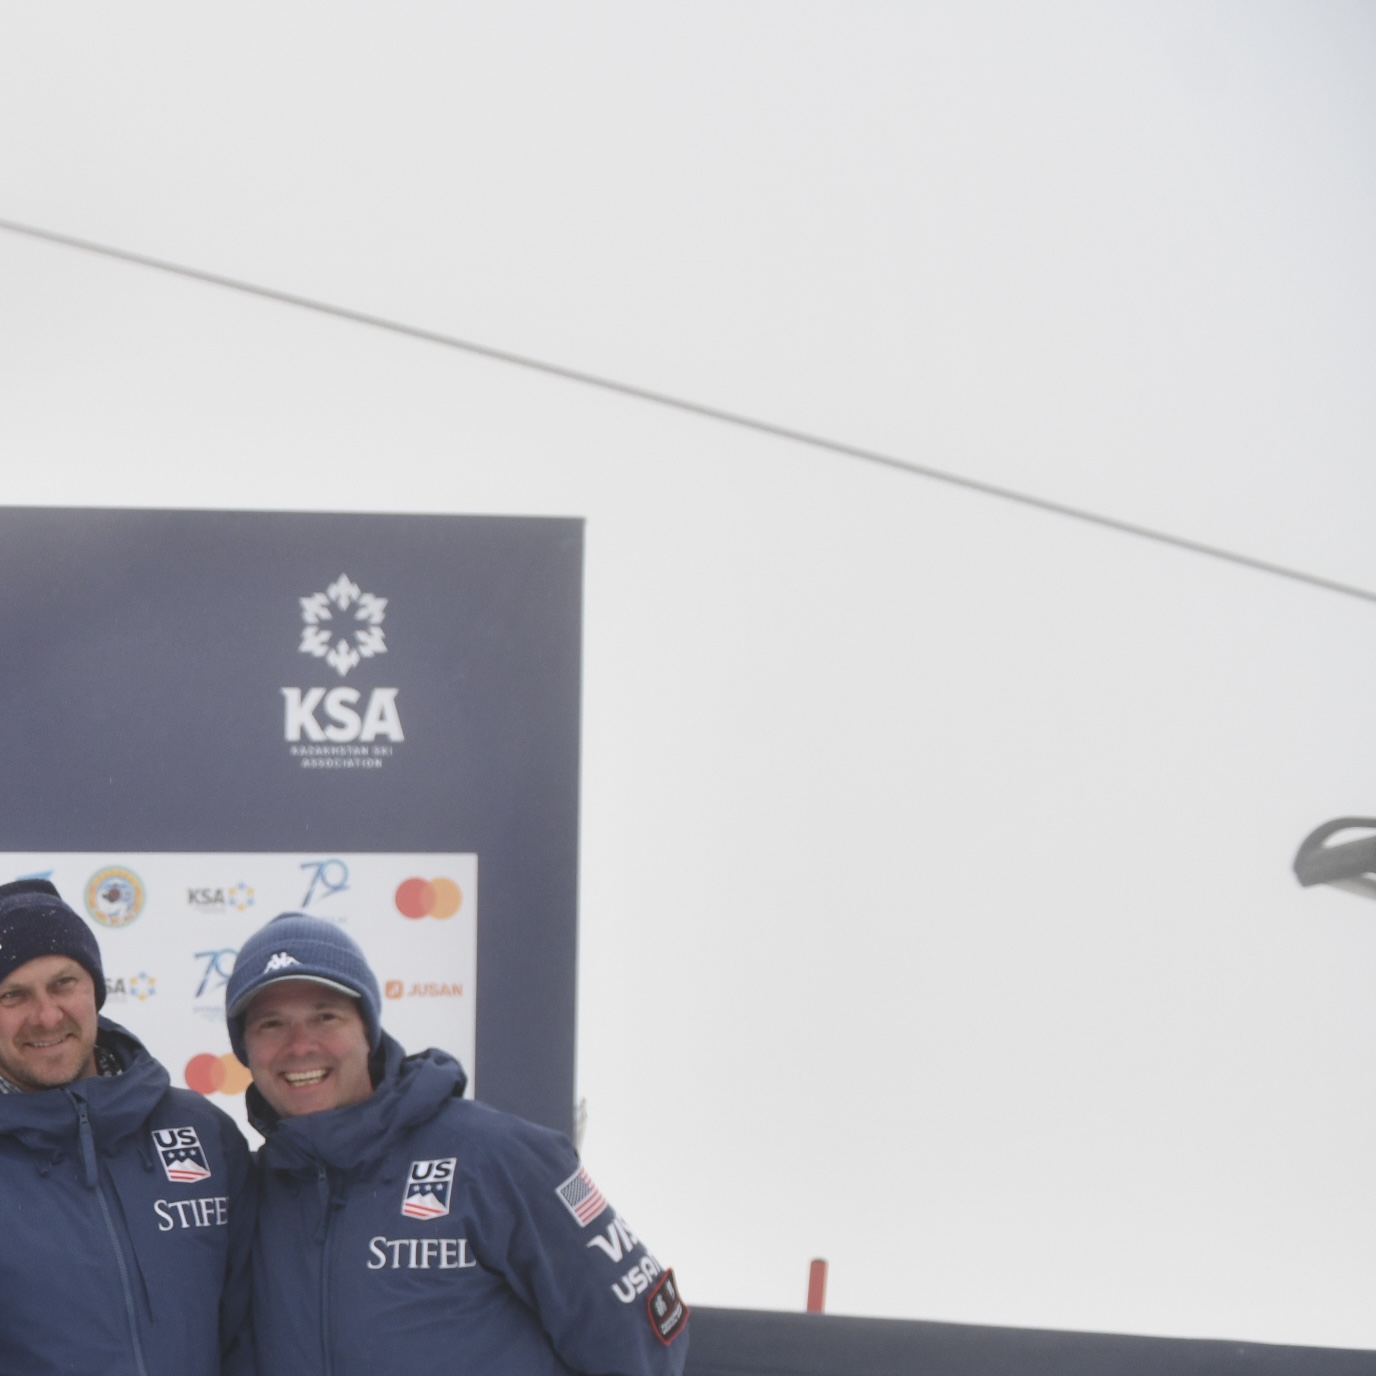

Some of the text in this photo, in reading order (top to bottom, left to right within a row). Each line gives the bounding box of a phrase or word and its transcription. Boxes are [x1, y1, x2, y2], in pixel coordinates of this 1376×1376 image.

[280, 686, 405, 743] KSA
[187, 888, 225, 905] KSA
[408, 984, 463, 998] JUSAN
[154, 1129, 197, 1148] US
[411, 1160, 453, 1181] US
[153, 1196, 229, 1231] STIFE
[367, 1236, 477, 1270] STIFEL
